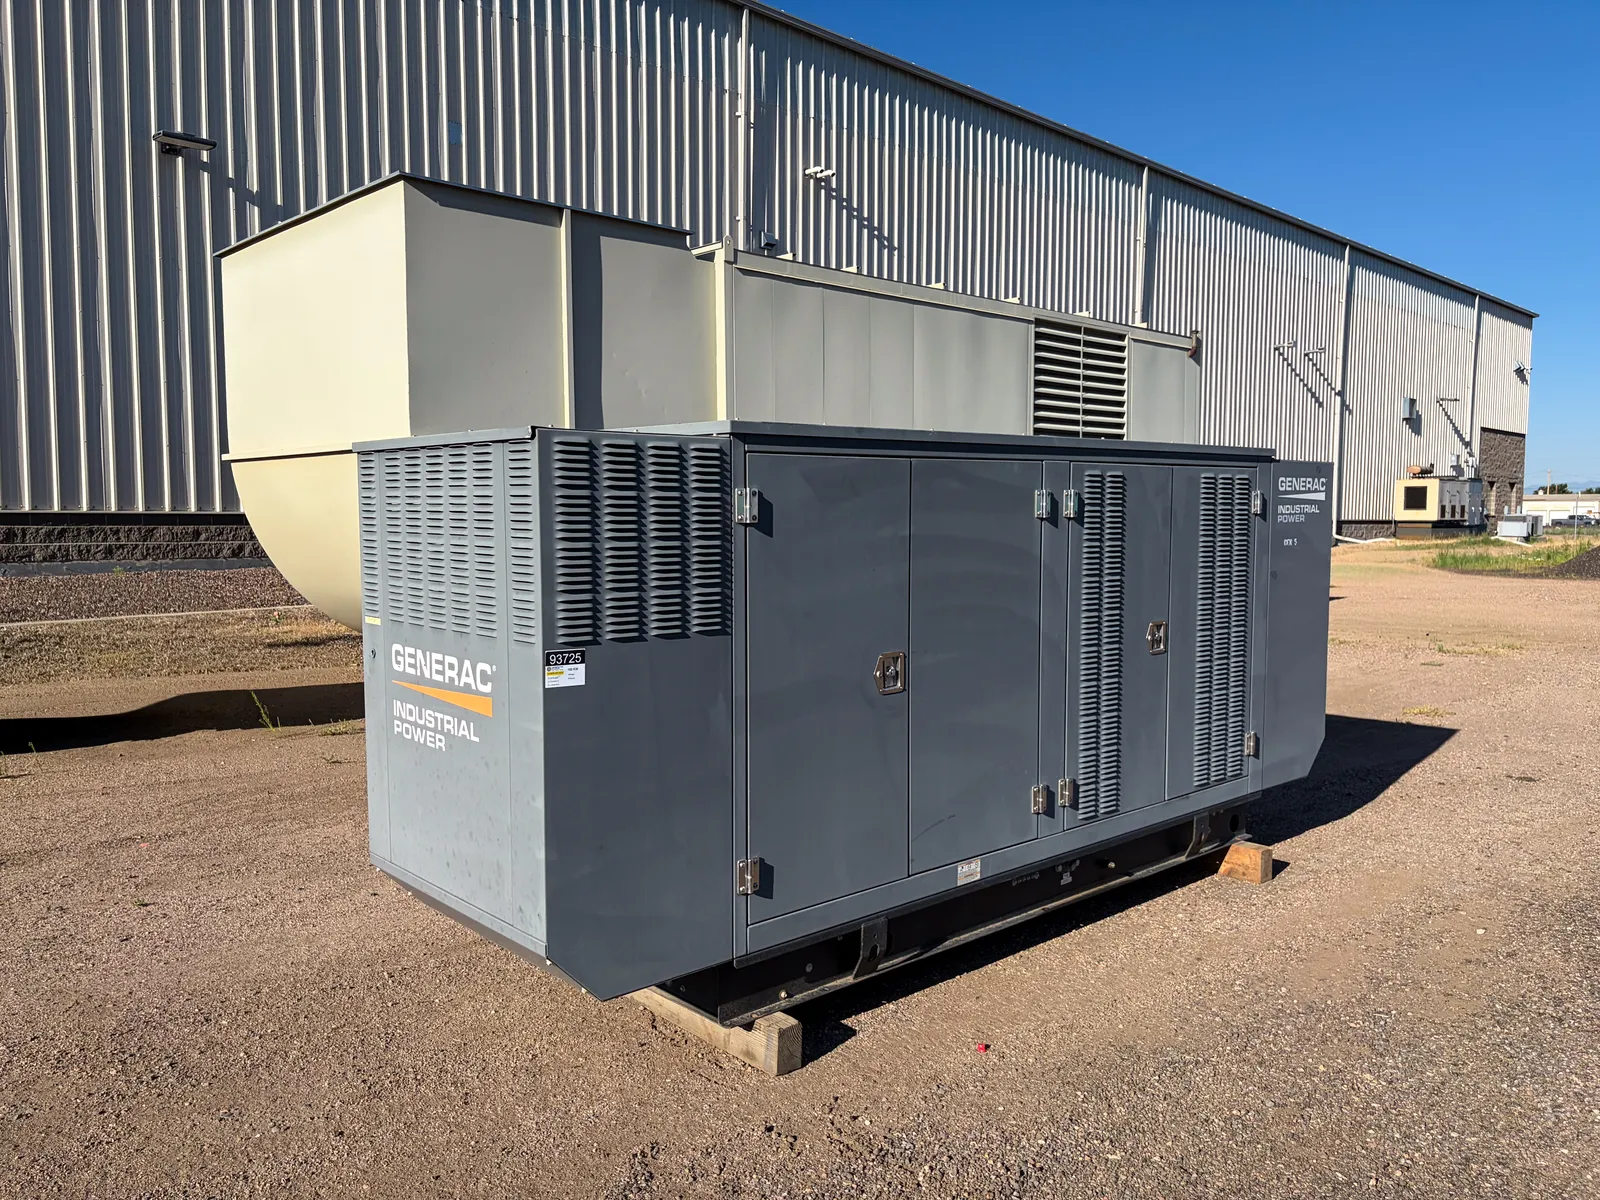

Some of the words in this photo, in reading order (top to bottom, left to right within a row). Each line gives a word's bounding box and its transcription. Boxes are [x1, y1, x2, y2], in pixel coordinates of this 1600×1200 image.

[1278, 477, 1326, 491] GENERAC
[1278, 505, 1319, 513] INDUSTRIAL
[1278, 514, 1305, 523] POWER
[549, 652, 582, 665] 93725
[392, 643, 492, 692] GENERAC
[393, 699, 480, 743] INDUSTRIAL
[394, 719, 446, 751] POWER
